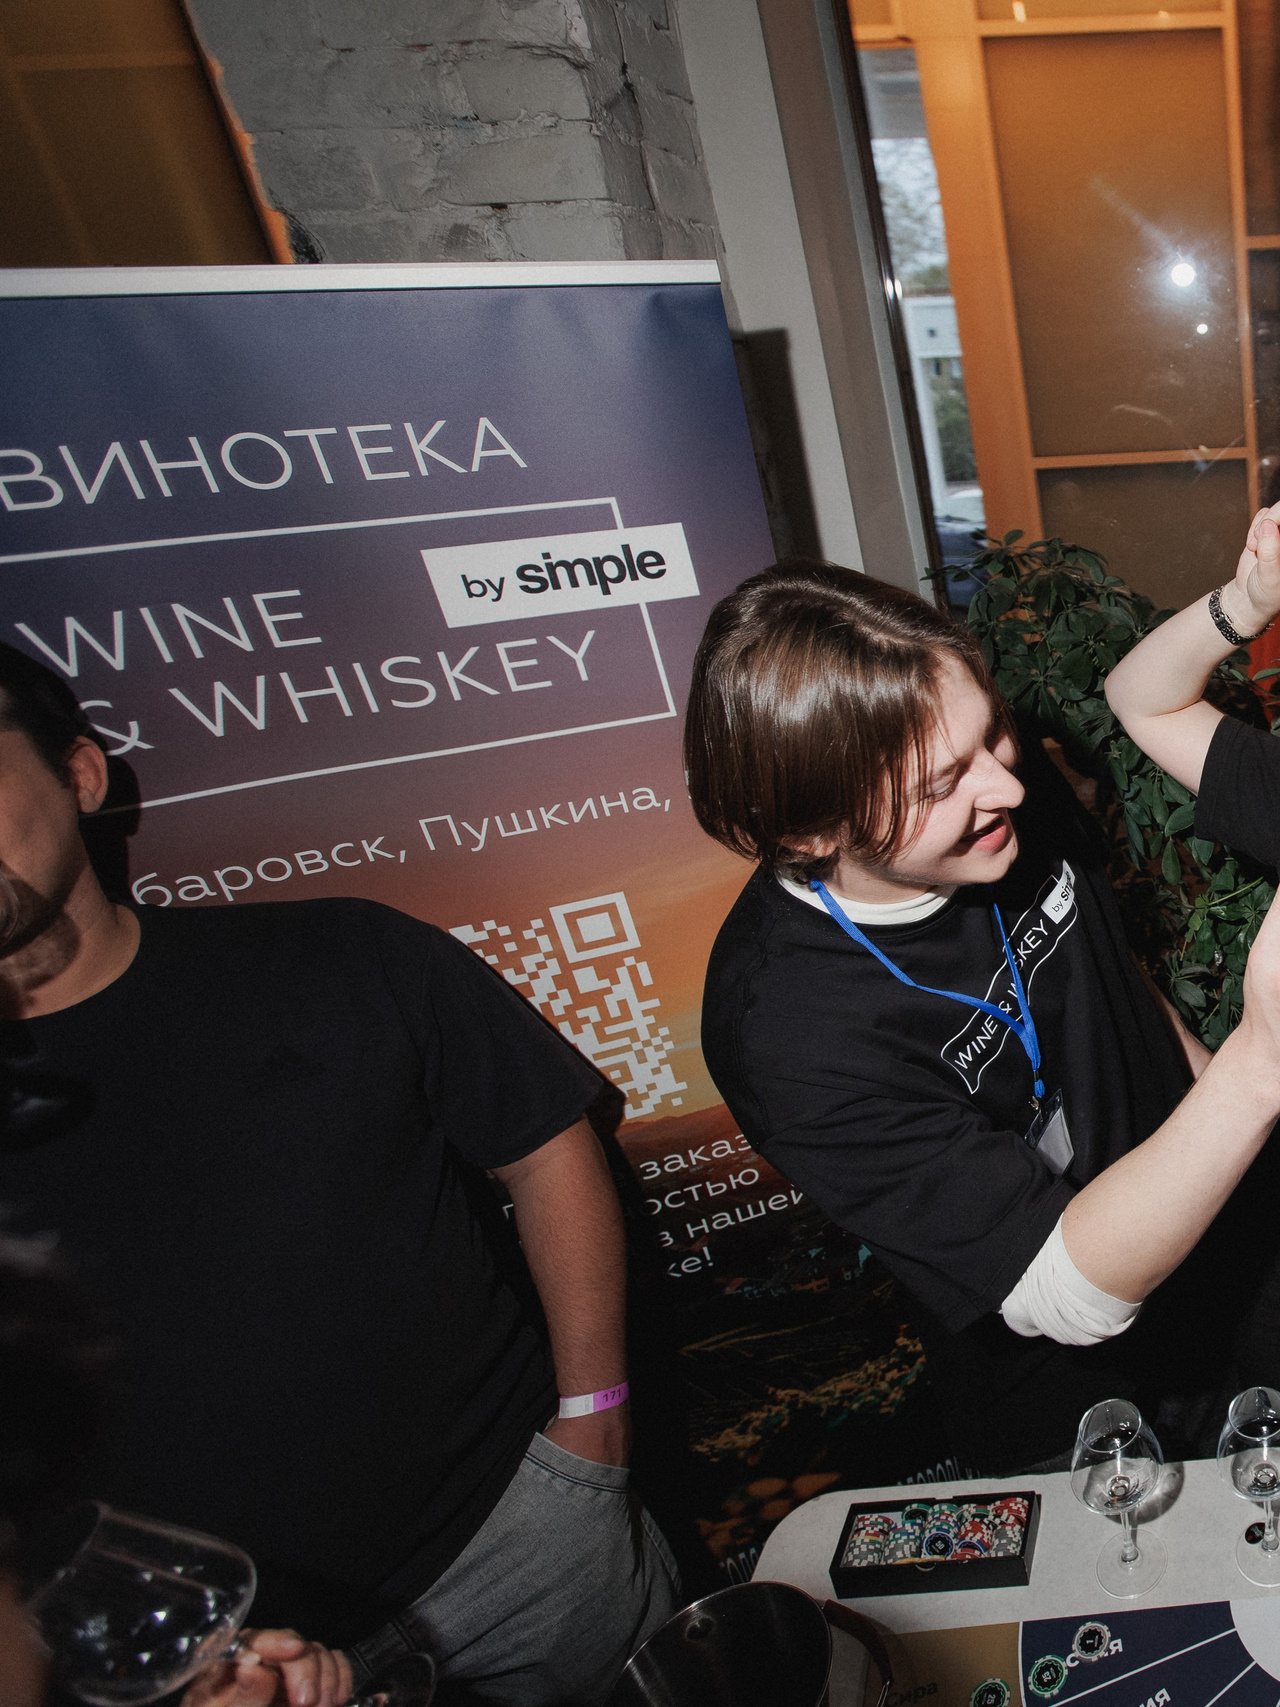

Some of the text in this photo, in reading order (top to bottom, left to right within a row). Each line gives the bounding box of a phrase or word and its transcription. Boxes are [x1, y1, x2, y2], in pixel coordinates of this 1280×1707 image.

[0, 416, 529, 513] ВИНОТЕКА
[461, 544, 667, 602] by simple
[14, 589, 323, 678] WINE
[168, 630, 599, 738] WHISKEY
[418, 786, 672, 852] Пушкина,
[954, 1014, 998, 1070] WINE
[1051, 901, 1064, 913] by
[603, 1388, 621, 1402] 171
